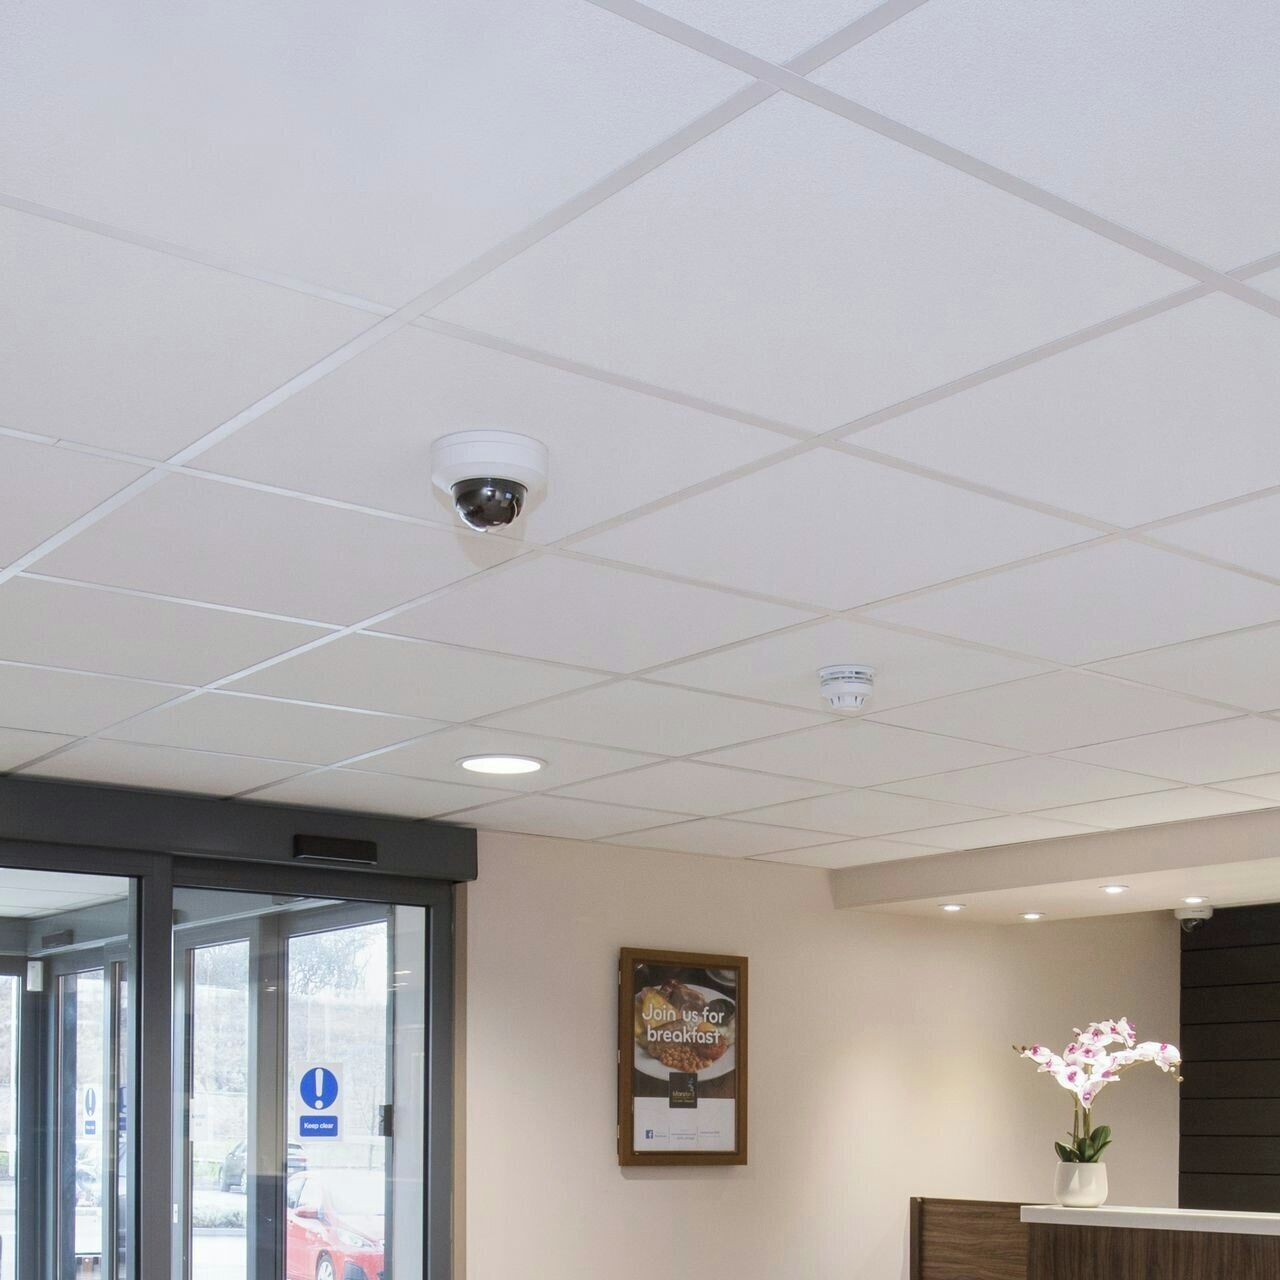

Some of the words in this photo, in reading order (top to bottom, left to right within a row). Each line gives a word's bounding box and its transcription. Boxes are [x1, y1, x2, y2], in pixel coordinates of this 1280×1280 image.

[642, 1003, 677, 1021] Join
[682, 1010, 699, 1022] us
[702, 1006, 725, 1024] for
[647, 1024, 721, 1044] breakfast
